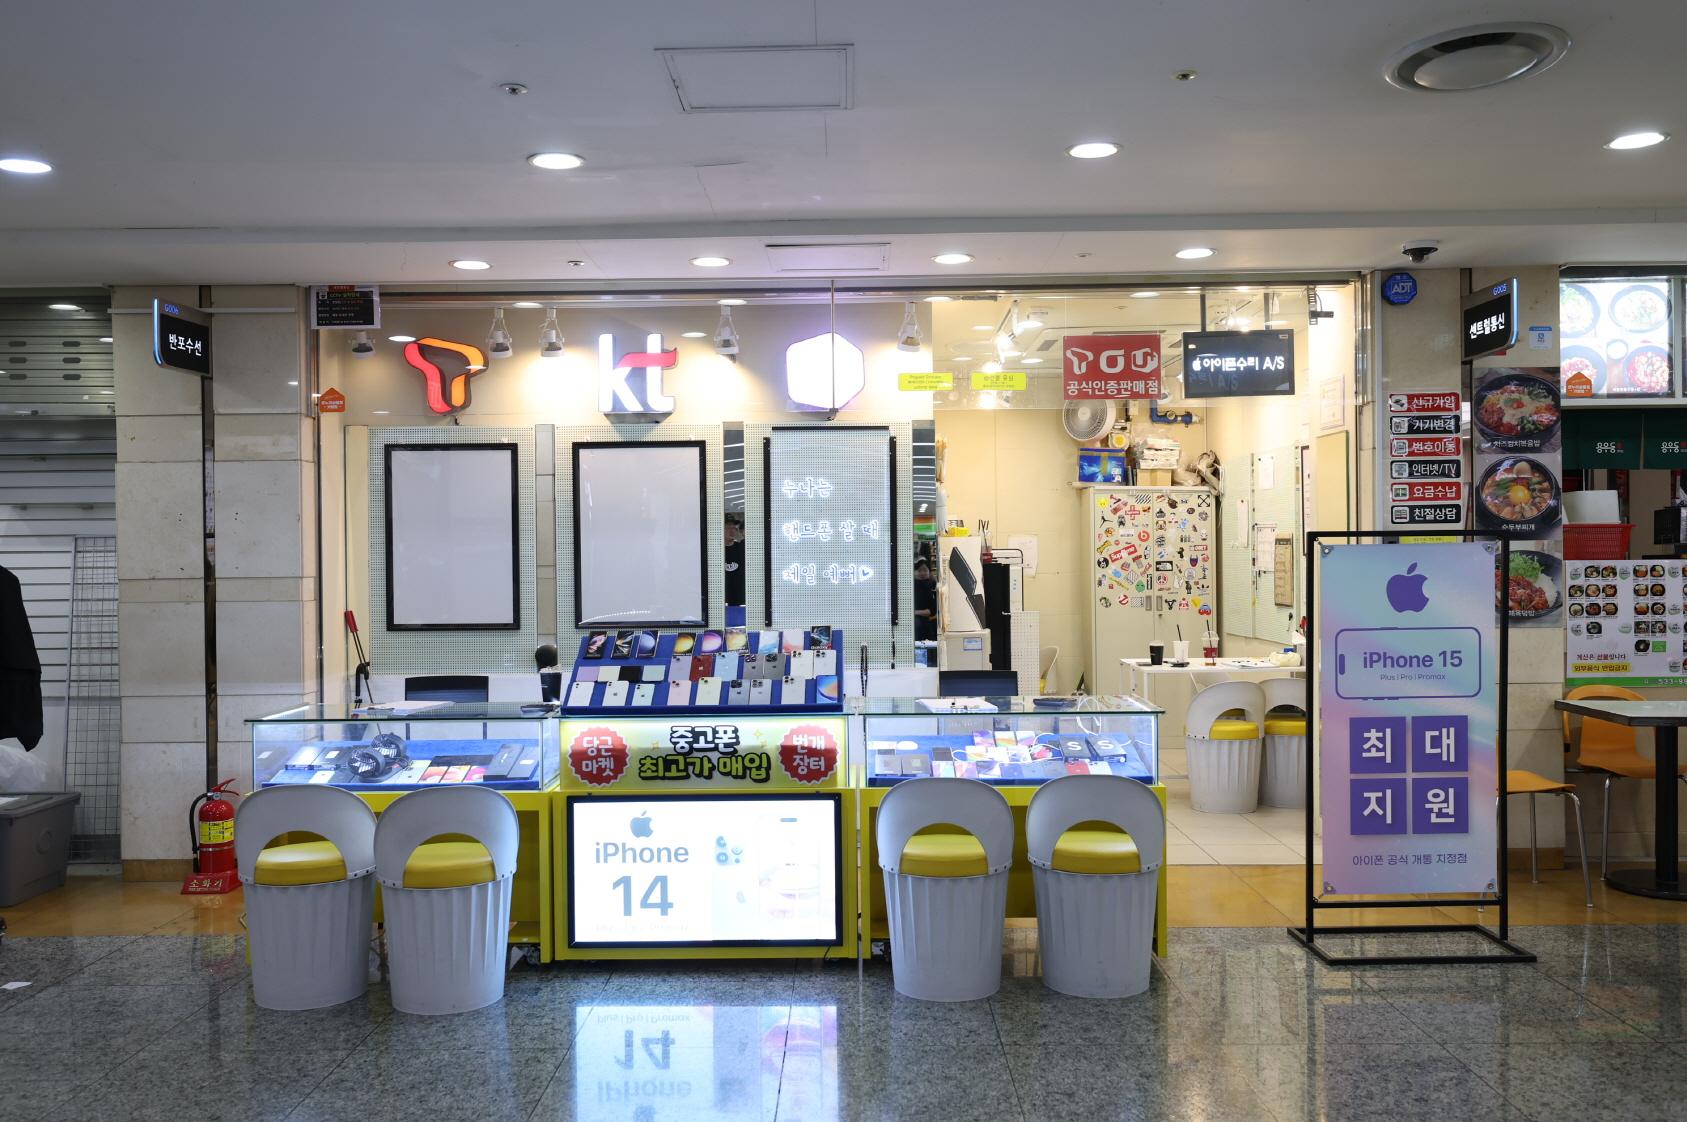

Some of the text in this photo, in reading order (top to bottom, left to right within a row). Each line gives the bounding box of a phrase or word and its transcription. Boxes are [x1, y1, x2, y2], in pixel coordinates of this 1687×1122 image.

[1391, 282, 1412, 294] ADT
[1469, 312, 1505, 339] 센트럴통신
[168, 334, 202, 356] 반포수선
[598, 333, 678, 413] kt
[1203, 356, 1285, 372] 아이폰수리 A/S
[1066, 380, 1159, 396] 공식인증판매점
[1412, 396, 1456, 409] 신규가입
[1412, 419, 1456, 431] 기기변경
[1412, 441, 1456, 453] 번호이동
[1412, 463, 1457, 476] 인터넷/TV
[783, 478, 833, 497] 누나는
[1413, 486, 1456, 498] 요금수납
[1413, 508, 1456, 520] 친절상담
[783, 520, 879, 541] 핸드폰 살 때
[783, 563, 856, 585] 제일 예뻐
[1363, 651, 1463, 669] iPhone 15
[1417, 673, 1446, 681] Promax
[583, 735, 614, 756] 당근
[671, 725, 741, 753] 중고폰
[793, 733, 824, 752] 번개
[581, 758, 614, 777] 마켓
[639, 752, 771, 782] 최고가 매입
[793, 755, 825, 774] 장터
[595, 841, 689, 864] iPhone
[1352, 853, 1468, 866] 아이폰 공식 개통 지정점
[612, 875, 674, 917] 14
